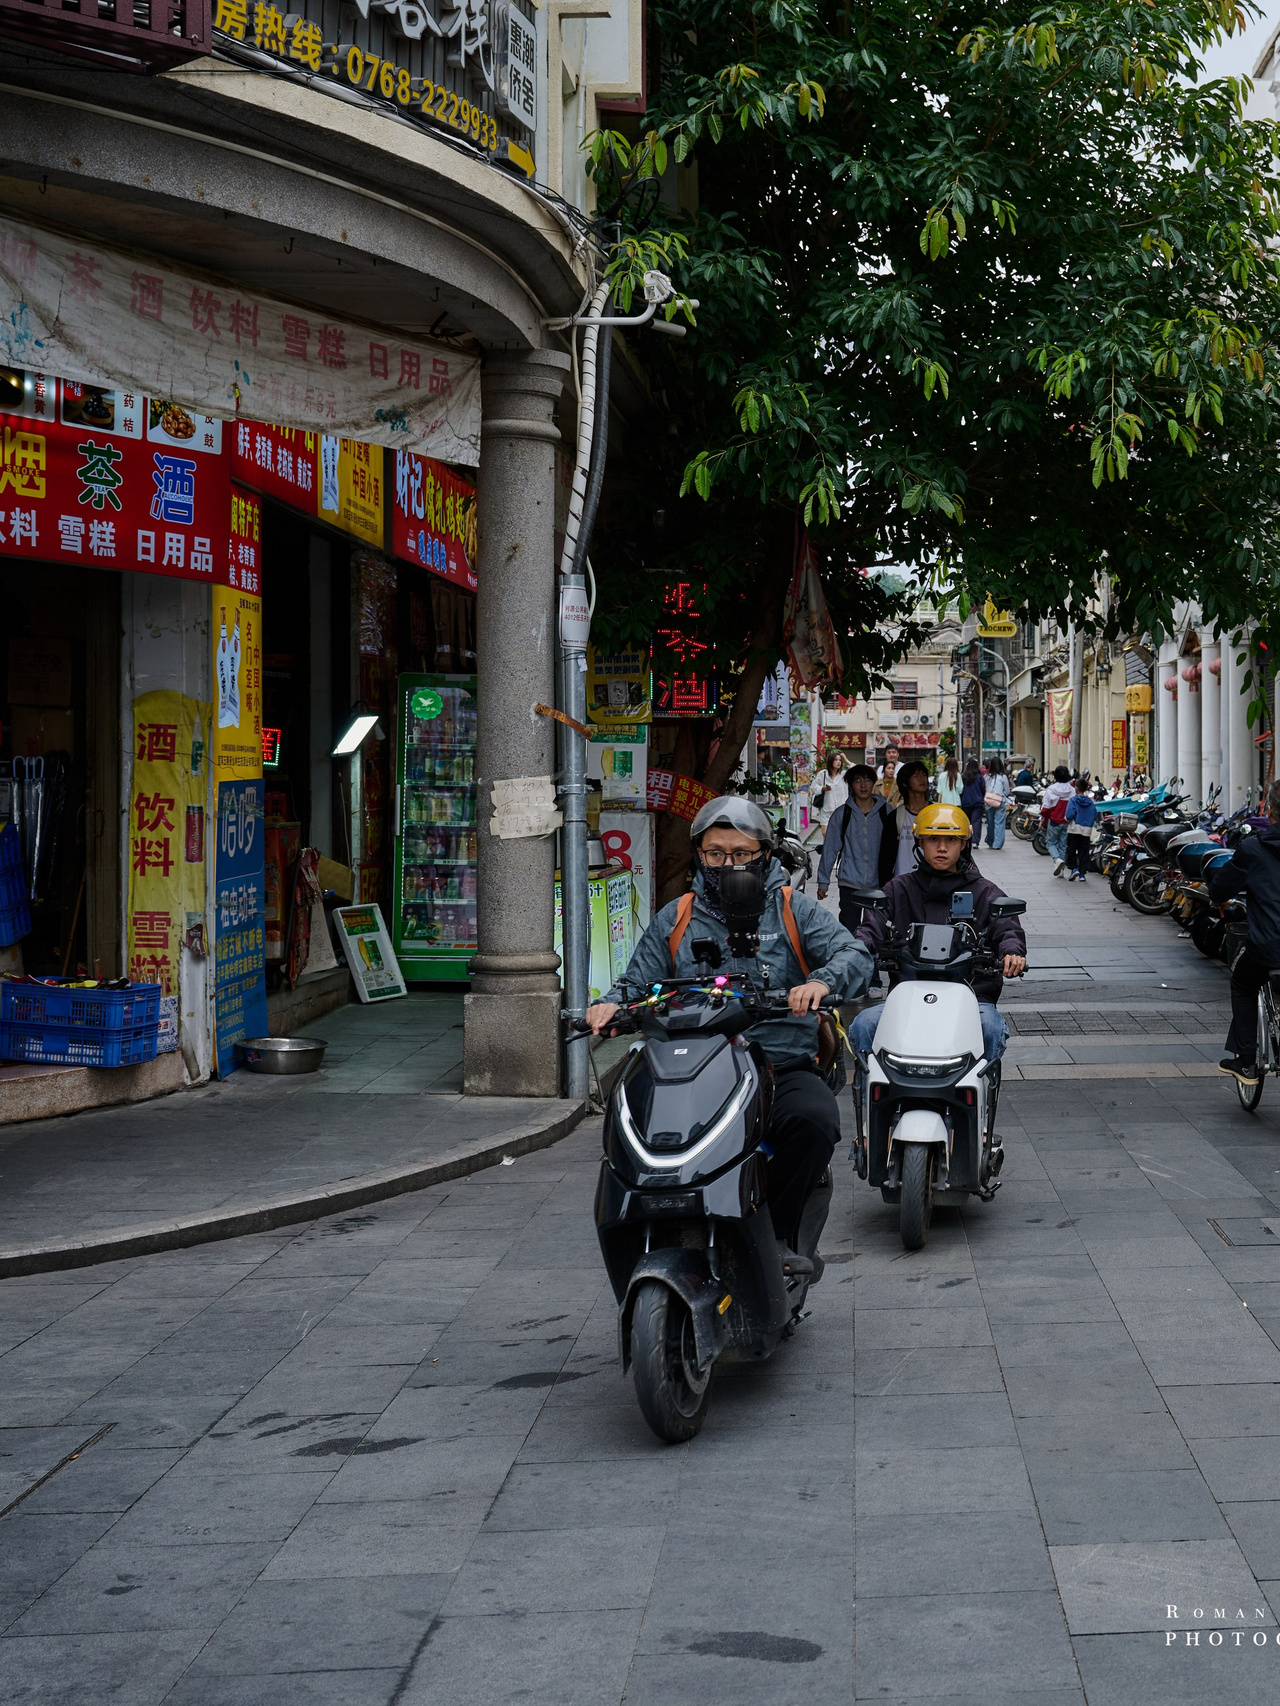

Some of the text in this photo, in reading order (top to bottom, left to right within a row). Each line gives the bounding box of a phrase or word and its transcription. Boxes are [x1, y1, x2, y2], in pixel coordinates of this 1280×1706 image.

[65, 251, 104, 303] 茶
[130, 269, 165, 323] 酒
[188, 286, 262, 349] 饮料
[281, 312, 349, 372] 雪糕
[367, 340, 455, 398] 日用品
[6, 463, 41, 478] SMOKE
[76, 438, 124, 512] 茶
[150, 451, 197, 526] 酒
[93, 484, 106, 494] TEA
[163, 492, 194, 504] ALCOHOLIC
[57, 514, 117, 558] 雪糕
[136, 528, 214, 574] 日用品
[252, 643, 261, 736] 中国小酒
[136, 721, 178, 764] 酒
[646, 769, 674, 808] 租车
[675, 789, 700, 810] 婴儿
[678, 777, 716, 801] 电动车
[132, 791, 176, 878] 饮料
